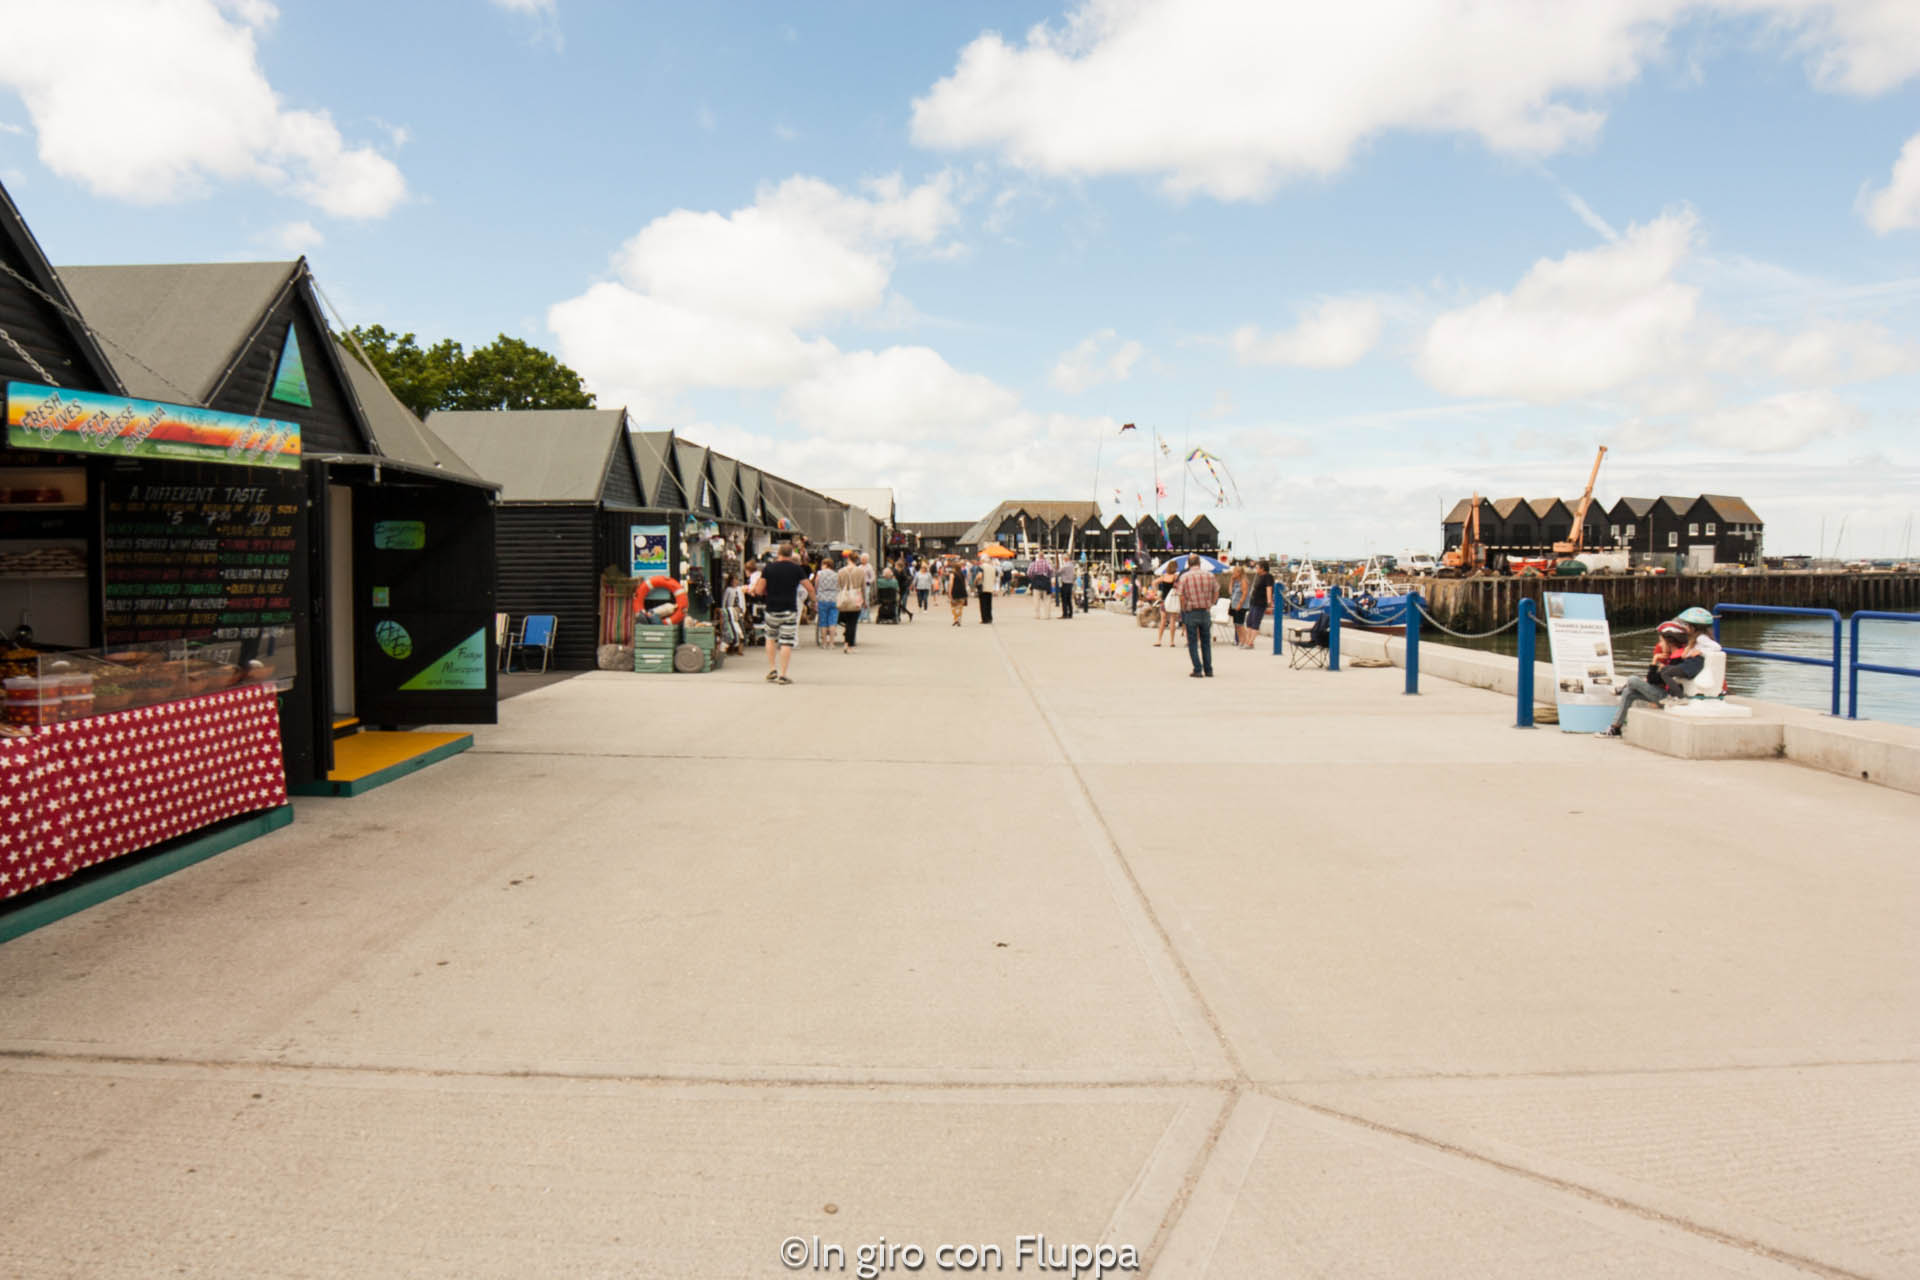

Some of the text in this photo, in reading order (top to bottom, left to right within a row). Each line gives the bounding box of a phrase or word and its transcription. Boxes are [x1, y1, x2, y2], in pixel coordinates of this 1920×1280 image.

[20, 391, 62, 434] FRESH
[40, 400, 83, 442] OLIVES
[78, 409, 110, 443] FETA
[96, 405, 136, 449] CHEESE
[122, 406, 167, 453] BAKLAVA
[130, 486, 268, 503] A DIFFERENT TASTE
